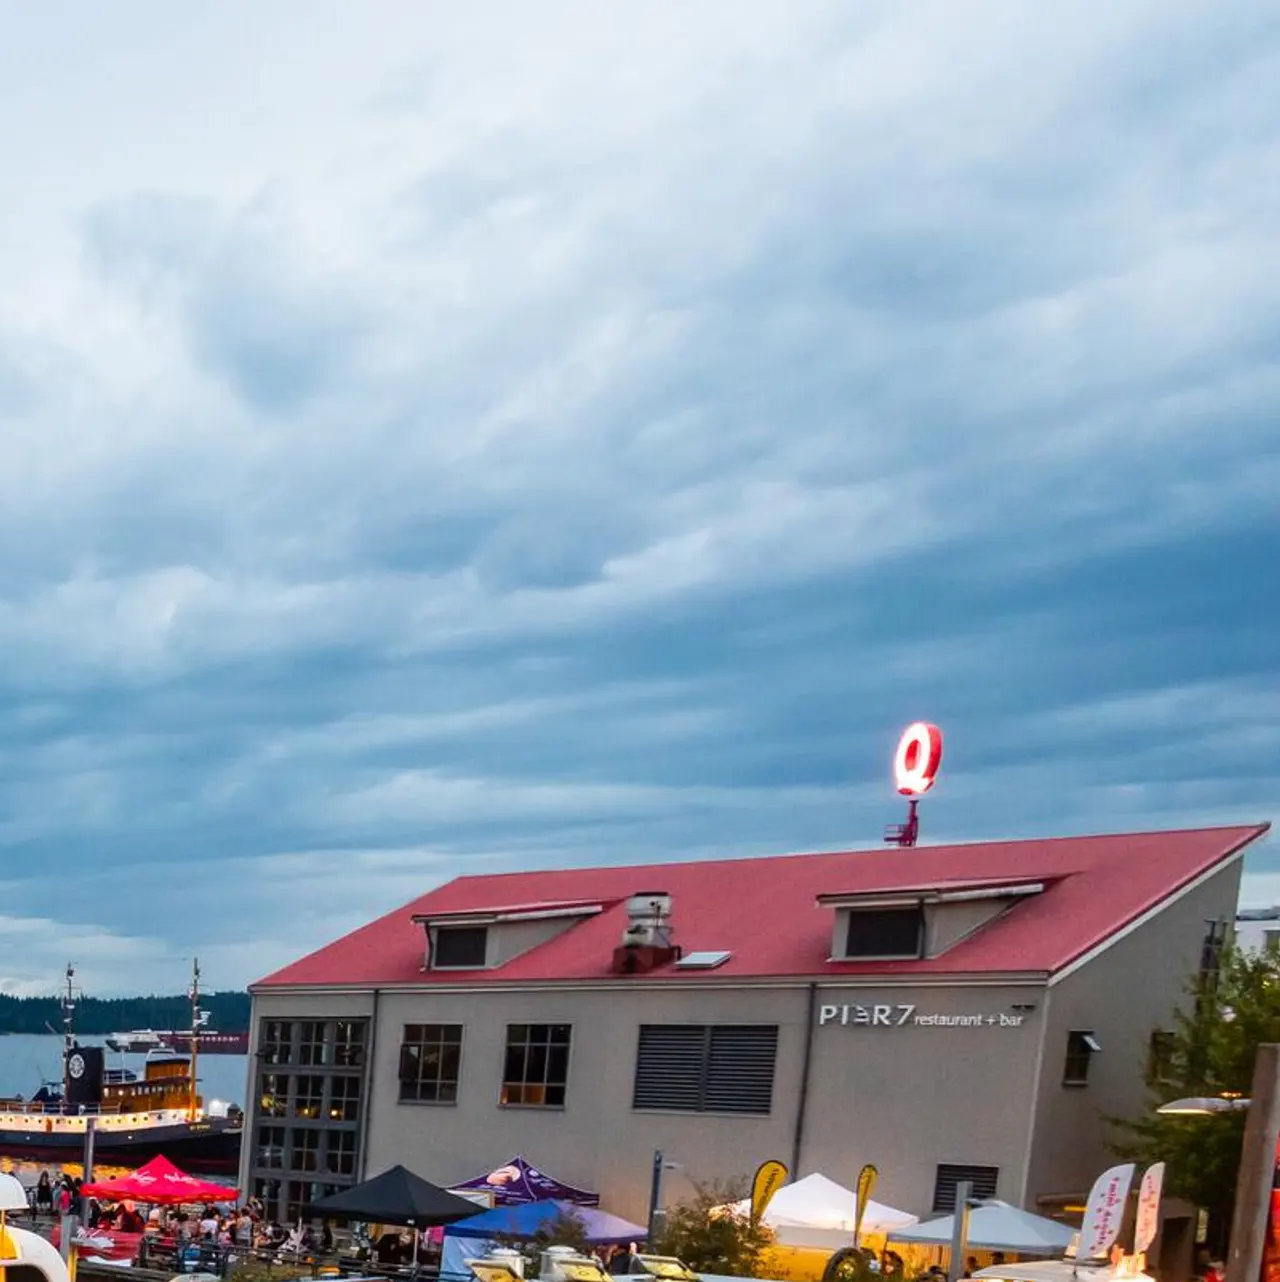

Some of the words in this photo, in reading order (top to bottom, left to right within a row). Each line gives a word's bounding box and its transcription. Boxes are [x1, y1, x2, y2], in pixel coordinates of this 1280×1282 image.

[896, 1004, 916, 1025] 7
[914, 1013, 982, 1026] restaurant
[1000, 1013, 1024, 1026] bar
